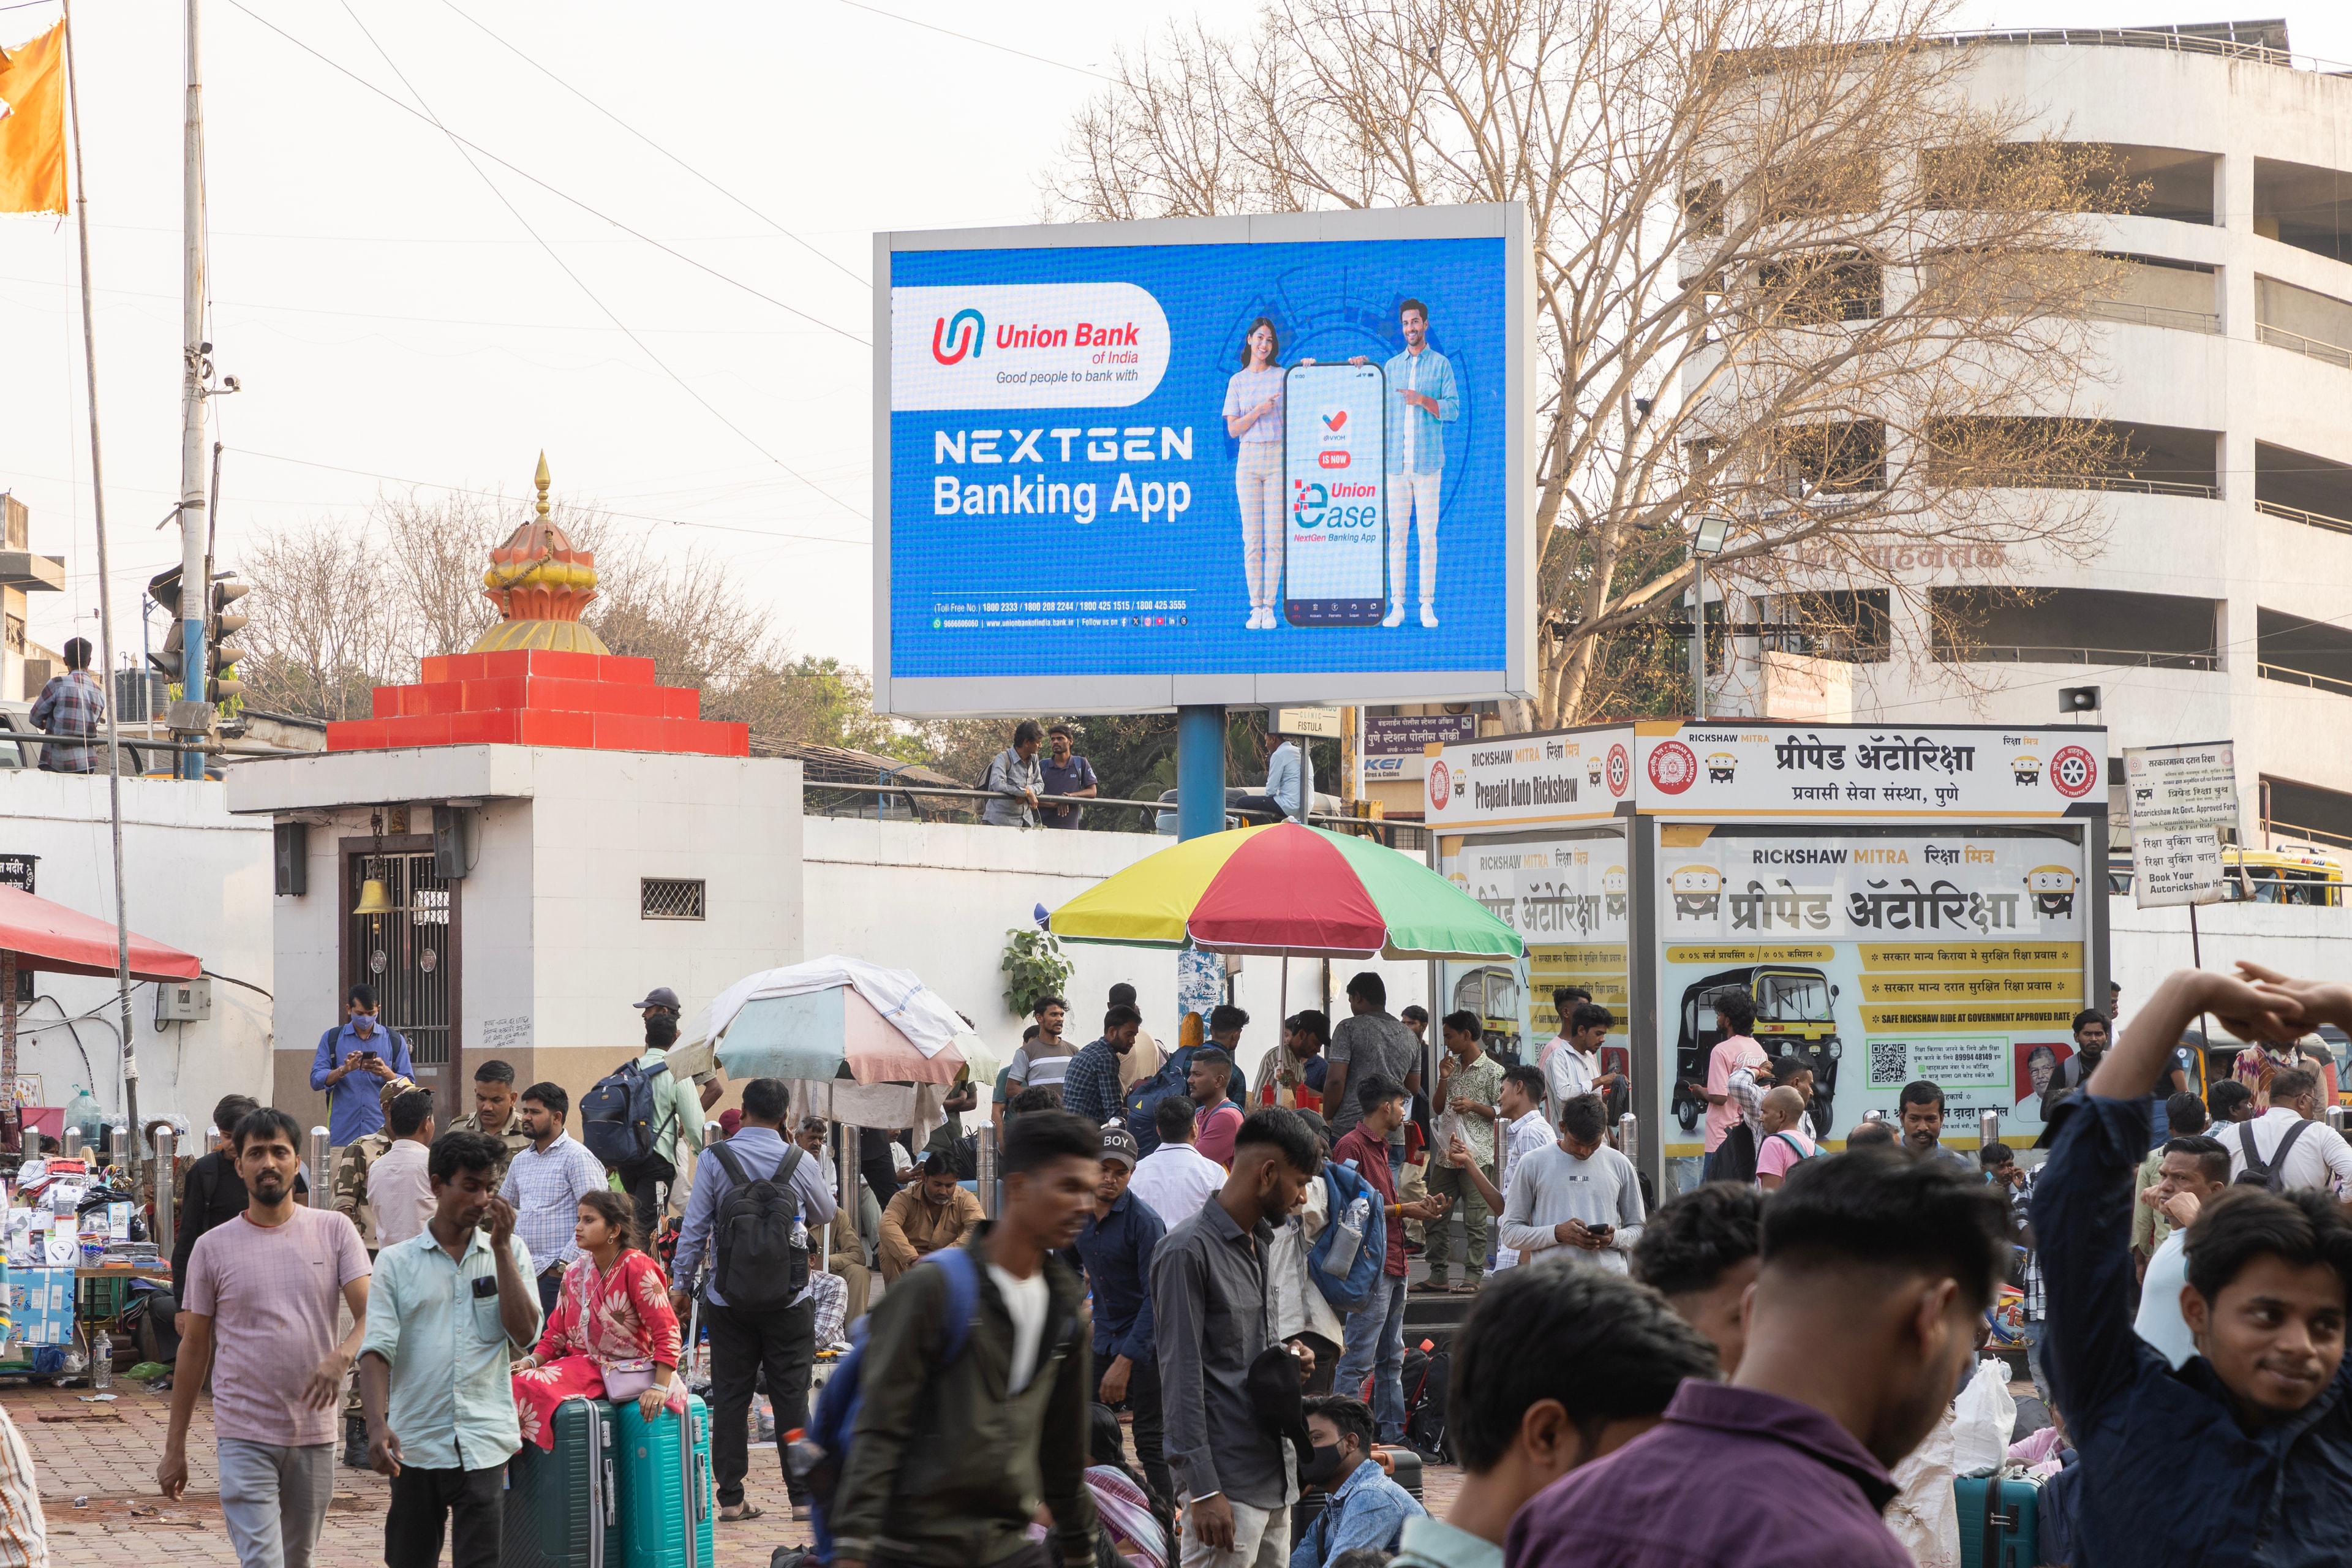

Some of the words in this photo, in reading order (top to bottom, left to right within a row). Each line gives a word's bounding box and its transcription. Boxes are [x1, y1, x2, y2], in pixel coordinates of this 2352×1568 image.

[996, 323, 1067, 349] Union
[1074, 322, 1140, 347] Bank
[1093, 352, 1104, 364] of
[1108, 351, 1138, 364] India
[997, 372, 1027, 384] Good
[1030, 371, 1068, 386] people
[1071, 372, 1082, 382] to
[1085, 370, 1112, 382] bank
[1115, 369, 1138, 382] with
[935, 426, 1193, 464] NEXTGEN
[1322, 455, 1329, 464] IS
[1331, 454, 1347, 464] NOW
[1331, 482, 1377, 498] Union
[935, 473, 1096, 524] Banking
[1110, 473, 1191, 523] App
[1294, 533, 1326, 542] NextGen
[1328, 533, 1359, 543] Banking
[1360, 533, 1376, 543] App
[934, 603, 949, 614] (Toll
[951, 603, 965, 612] Free
[967, 603, 980, 614] No.)
[982, 603, 999, 612] 1800
[1001, 602, 1017, 612] 2333
[1024, 602, 1041, 611] 1800
[1042, 602, 1055, 611] 208
[1057, 601, 1073, 611] 2244
[1080, 601, 1096, 611] 1800
[1098, 601, 1111, 611] 425
[1113, 601, 1130, 610] 1515
[1136, 601, 1153, 610] 1800
[1155, 601, 1167, 609] 425
[1169, 600, 1186, 609] 3555
[1298, 722, 1322, 732] FISTULA
[1402, 718, 1419, 726] पोलीस
[1421, 717, 1436, 726] स्टेशन
[1368, 731, 1381, 747] पुणे
[1383, 730, 1407, 744] स्टेशन
[1409, 729, 1436, 742] पोलीस
[1438, 728, 1460, 741] चौकी
[1689, 734, 1738, 742] RICKSHAW
[1741, 734, 1770, 743] MITRA
[2003, 735, 2021, 747] रिक्षा
[2023, 735, 2039, 745] मित्र
[1472, 749, 1512, 767] RICKSHAW
[1515, 747, 1540, 763] MITRA
[1546, 741, 1563, 761] रिक्षा
[1565, 739, 1580, 758] मित्र
[1669, 744, 1687, 755] INDIAN
[1775, 734, 1846, 771] प्रीपेड
[1365, 758, 1404, 770] KEI
[2185, 756, 2200, 764] दरात
[2201, 753, 2215, 763] रिक्षा
[1476, 780, 1509, 812] Prepaid
[1511, 778, 1531, 807] Auto
[1533, 774, 1578, 805] Rickshaw
[1792, 782, 1839, 801] प्रवासी
[1845, 782, 1876, 801] सेवा
[1882, 782, 1928, 803] संस्था,
[1934, 782, 1959, 807] पुणे
[2059, 785, 2068, 794] CITY
[2193, 787, 2212, 796] रिक्षा
[2133, 808, 2171, 818] Autorickshaw
[2173, 807, 2179, 815] At
[2180, 805, 2196, 815] Govt.
[2196, 804, 2222, 815] Approved
[2223, 802, 2236, 811] Fare
[2143, 837, 2162, 849] रिक्षा
[2166, 834, 2192, 850] बुकिंग
[2195, 834, 2216, 846] चालु
[1480, 855, 1521, 870] RICKSHAW
[1524, 854, 1548, 868] MITRA
[1555, 848, 1572, 868] रिक्षा
[1574, 846, 1589, 865] मित्र
[1753, 849, 1847, 864] RICKSHAW
[1854, 849, 1909, 864] MITRA
[1924, 845, 1960, 866] रिक्षा
[1964, 845, 1995, 864] मित्र
[2144, 856, 2164, 867] रिक्षा
[2167, 852, 2193, 868] बुकिंग
[2196, 853, 2217, 864] चालु
[6, 858, 24, 875] मंदीर
[2149, 873, 2170, 883] Book
[2173, 871, 2194, 881] Your
[2150, 881, 2211, 894] Autorickshaw
[1729, 879, 1832, 930] प्रीपेड
[1703, 949, 1716, 959] सर्ज
[1787, 949, 1813, 959] कमिशन
[1883, 952, 1910, 962] सरकार
[1914, 952, 1934, 961] मान्य
[1937, 949, 1967, 961] किराया
[1970, 949, 1978, 960] मे
[1981, 949, 2009, 963] सुरक्षित
[2013, 948, 2032, 960] रिक्षा
[2034, 951, 2057, 960] प्रवास
[1884, 984, 1915, 993] सरकार
[1918, 982, 1940, 992] मान्य
[1944, 982, 1965, 992] दरात
[1969, 979, 2000, 995] सुरक्षित
[2004, 978, 2024, 992] रिक्षा
[2027, 981, 2052, 990] प्रवास
[1882, 1014, 1899, 1023] SAFE
[1900, 1014, 1939, 1023] RICKSHAW
[1940, 1013, 1956, 1023] RIDE
[1958, 1013, 1967, 1022] AT
[1967, 1012, 2015, 1022] GOVERNMENT
[2016, 1012, 2052, 1022] APPROVED
[2054, 1012, 2070, 1021] RATE
[1944, 1091, 1963, 1100] हकार्य
[1954, 1107, 1975, 1120] दादा
[1104, 1136, 1128, 1148] BOY
